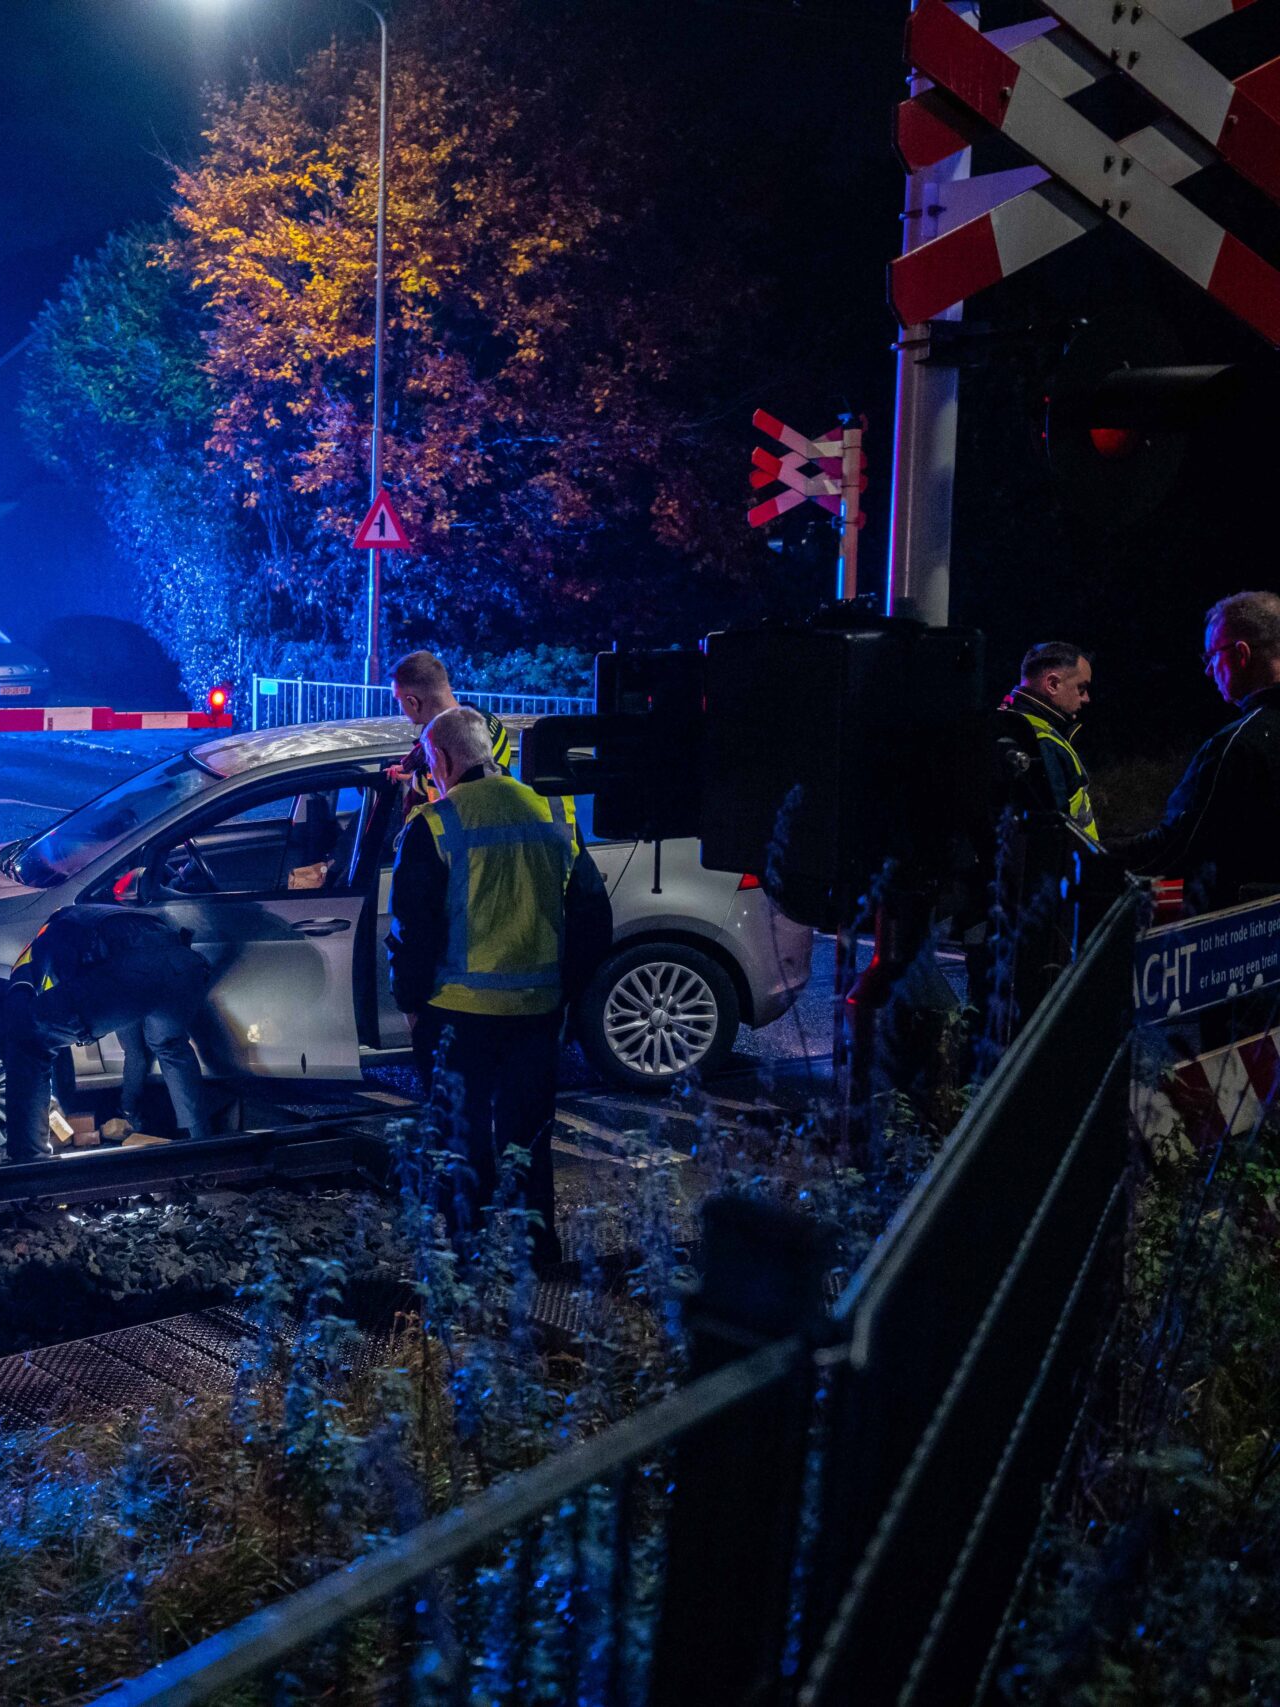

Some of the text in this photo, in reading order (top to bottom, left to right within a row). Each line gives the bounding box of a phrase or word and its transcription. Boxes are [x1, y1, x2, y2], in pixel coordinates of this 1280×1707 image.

[1200, 938, 1213, 952] tot
[1214, 932, 1228, 948] het
[1230, 926, 1248, 944] rode
[1249, 919, 1267, 938] licht
[1200, 951, 1278, 989] er kan nog een trein
